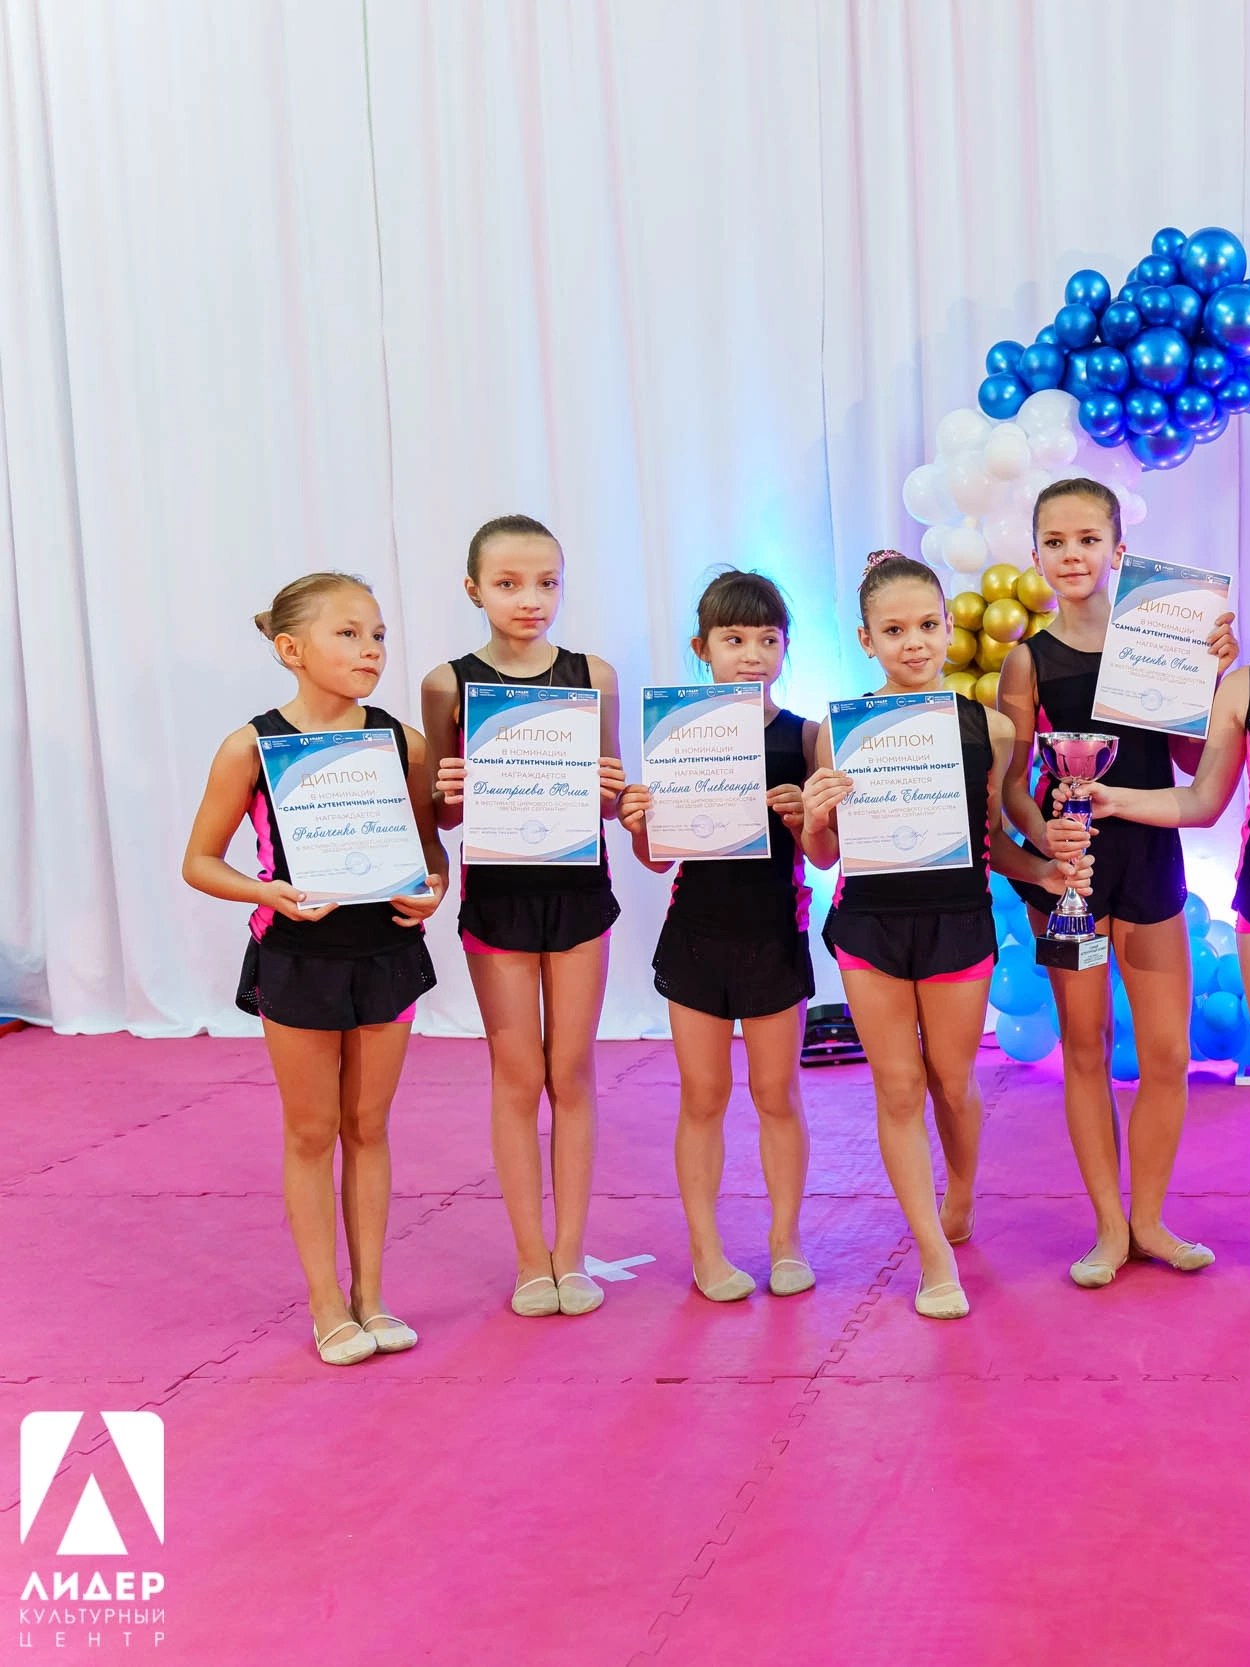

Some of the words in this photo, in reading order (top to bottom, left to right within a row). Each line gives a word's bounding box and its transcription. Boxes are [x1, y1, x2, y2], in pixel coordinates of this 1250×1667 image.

[1138, 598, 1203, 622] ДИПЛОМ
[1148, 621, 1195, 634] НОМИНАЦИИ
[1142, 629, 1190, 643] АУТЕНТИЧНЫЙ
[1136, 640, 1190, 655] НАГРАЖДАЕТСЯ
[1171, 657, 1199, 673] Анна
[496, 726, 572, 742] ДИПЛОМ
[669, 725, 738, 741] ДИПЛОМ
[861, 734, 933, 751] ДИПЛОМ
[679, 755, 730, 763] АУТЕНТИЧНЫЙ
[876, 755, 930, 763] НОМИНАЦИИ
[873, 764, 928, 773] АУТЕНТИЧНЫЙ
[300, 769, 377, 788] ДИПЛОМ
[870, 778, 932, 786] НАГРАЖДАЕТСЯ
[318, 790, 375, 799] НОМИНАЦИИ
[473, 781, 544, 800] Дмитриева
[549, 782, 589, 796] Юлия
[695, 778, 760, 797] Александра
[317, 798, 375, 809] АУТЕНТИЧНЫЙ
[901, 789, 960, 804] Екатерина
[316, 811, 380, 822] НАГРАЖДАЕТСЯ
